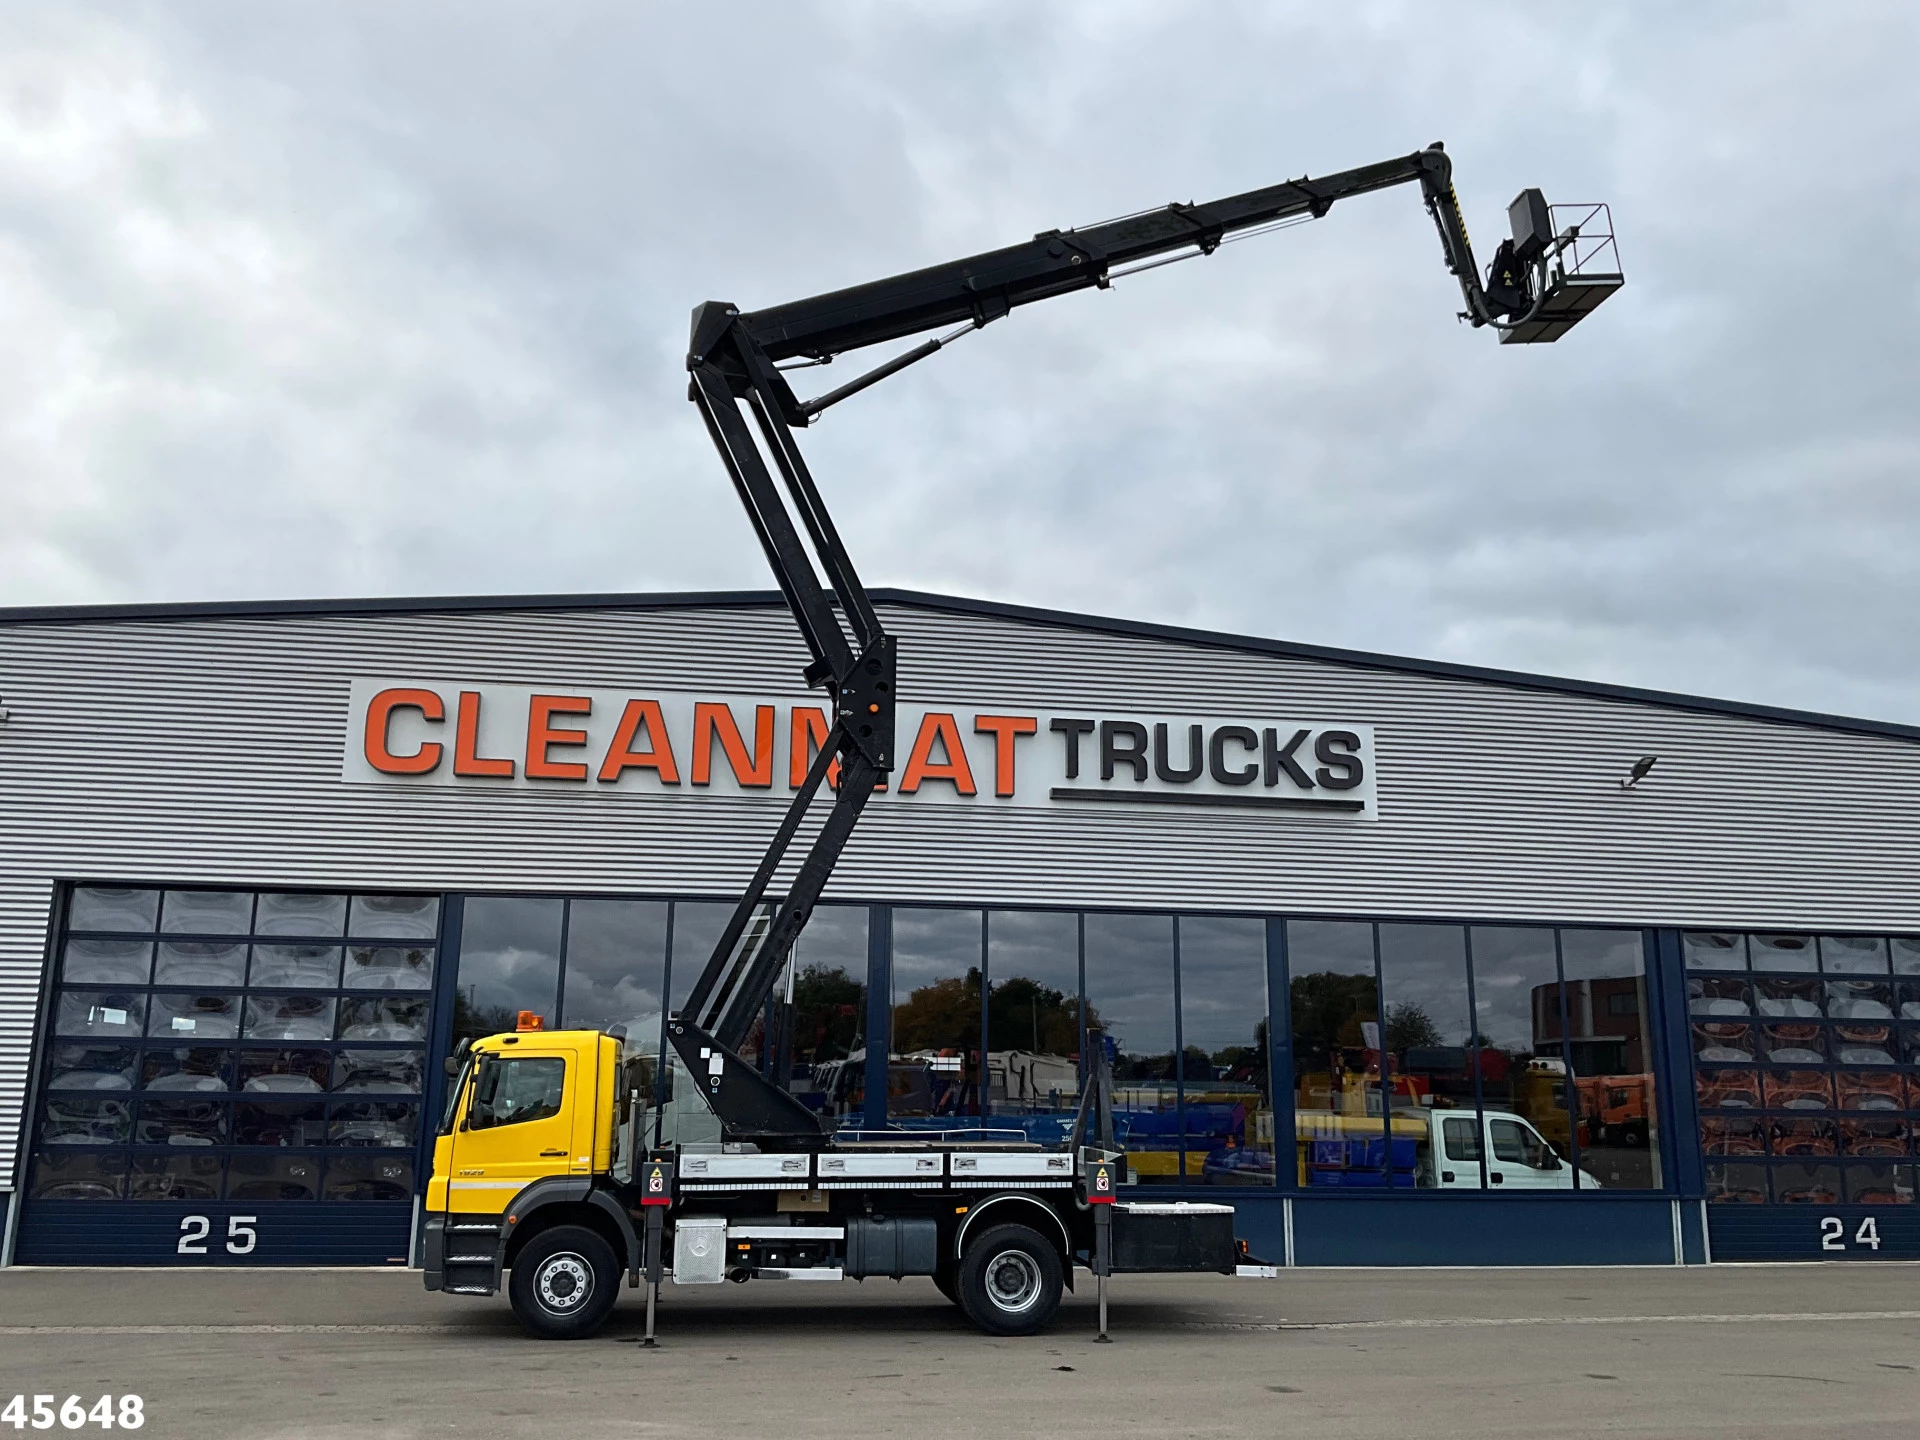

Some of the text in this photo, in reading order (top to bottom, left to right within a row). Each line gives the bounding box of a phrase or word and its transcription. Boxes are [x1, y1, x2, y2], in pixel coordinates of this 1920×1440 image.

[1049, 717, 1364, 790] TRUCKS
[177, 1215, 257, 1254] 25
[1820, 1216, 1881, 1250] 24
